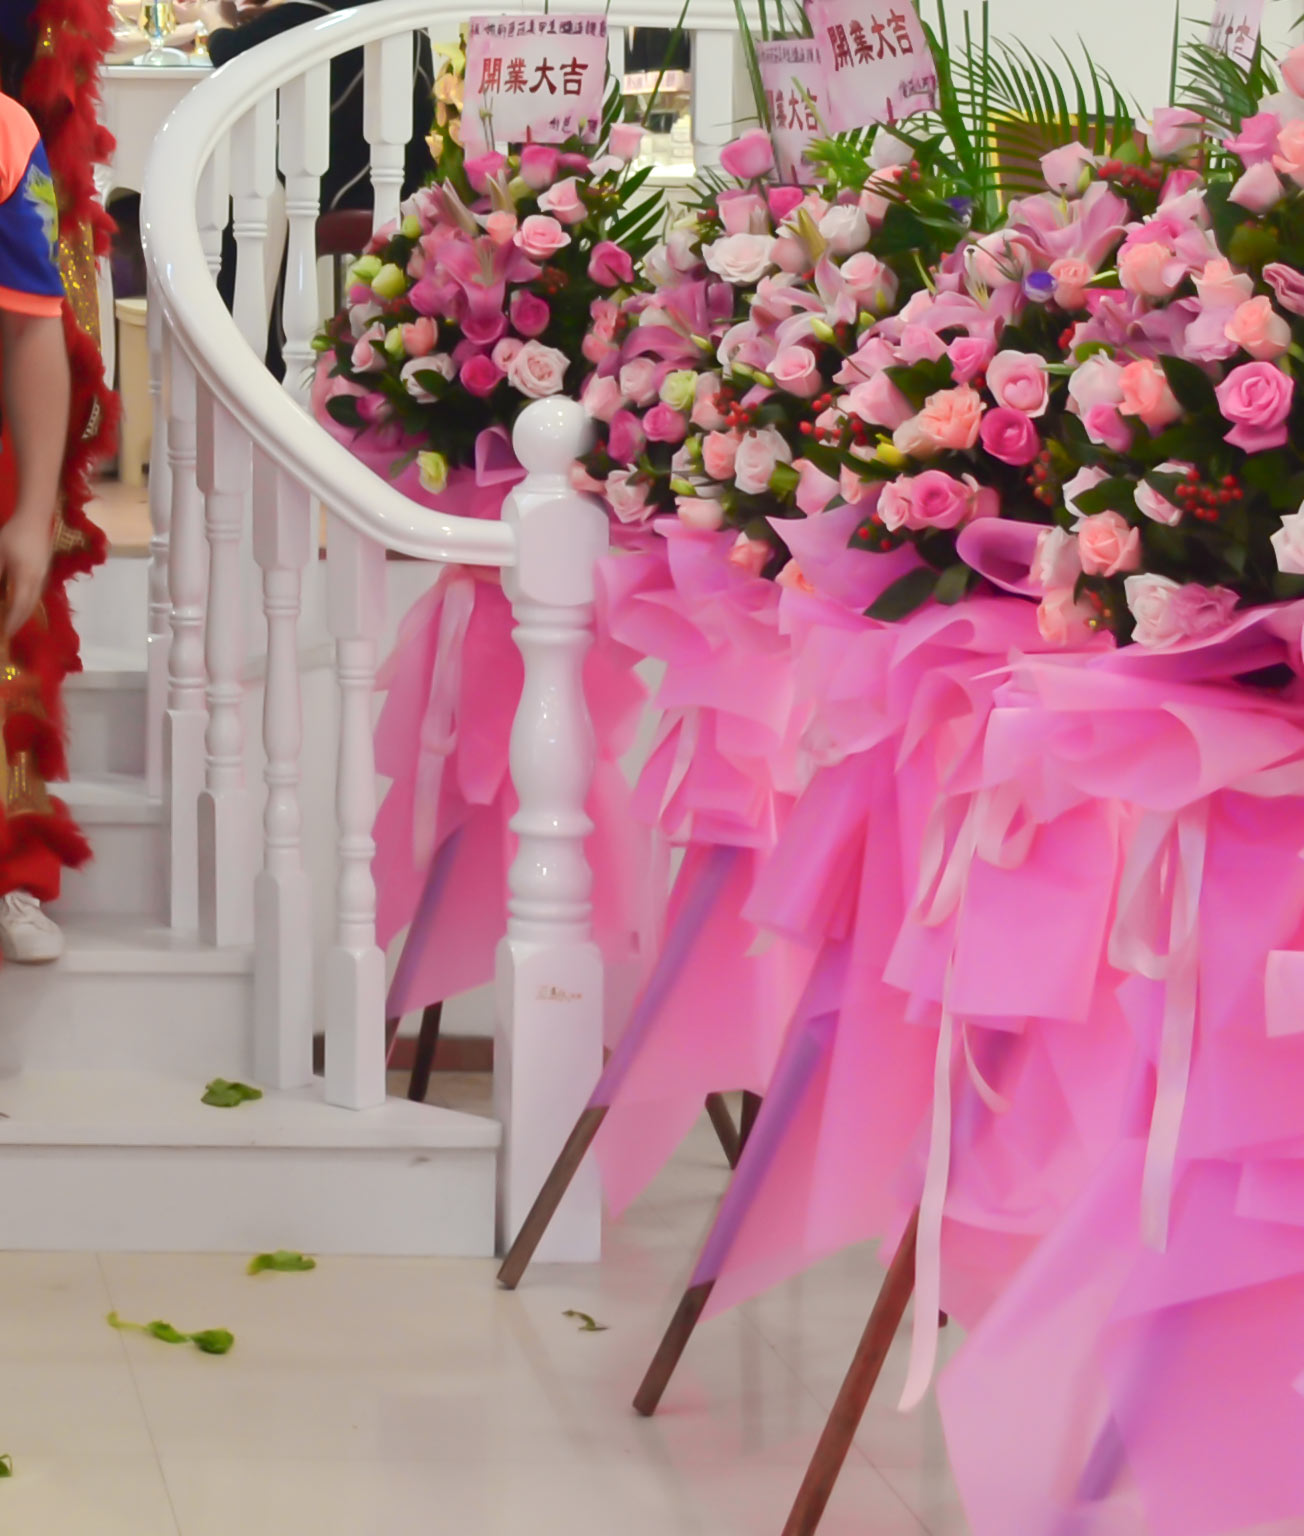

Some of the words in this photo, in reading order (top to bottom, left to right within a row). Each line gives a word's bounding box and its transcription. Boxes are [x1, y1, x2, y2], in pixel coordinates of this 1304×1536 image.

[827, 8, 914, 72] 開業大吉
[477, 56, 589, 96] 開業大吉
